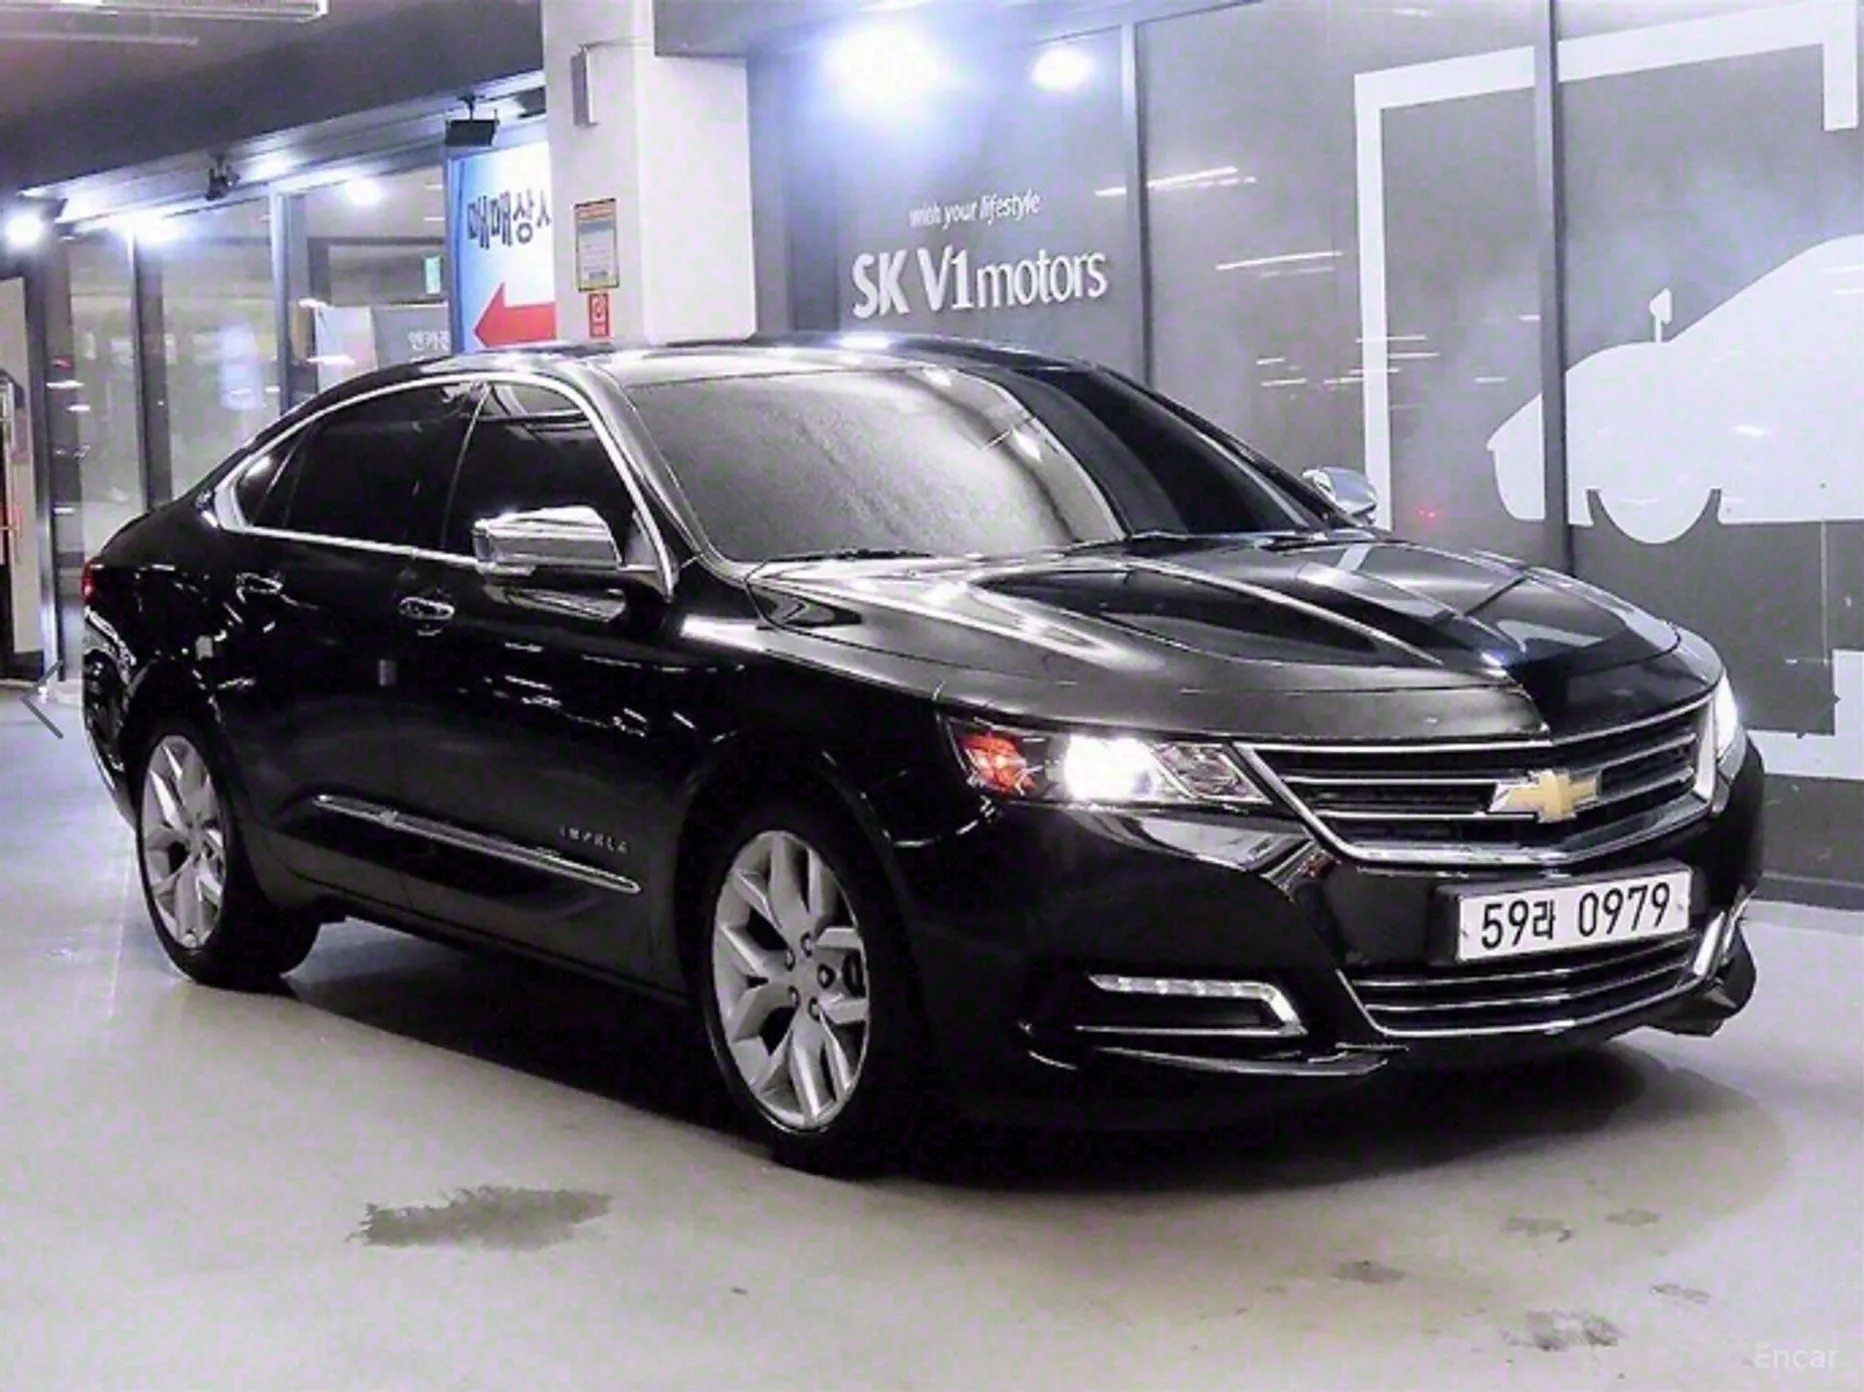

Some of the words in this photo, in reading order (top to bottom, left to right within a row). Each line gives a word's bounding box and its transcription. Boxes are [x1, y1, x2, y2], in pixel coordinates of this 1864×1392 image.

[942, 200, 978, 230] your
[979, 187, 1041, 227] lifestyle
[852, 250, 910, 319] SK
[1481, 898, 1556, 950] 59라
[1578, 881, 1672, 938] 0979
